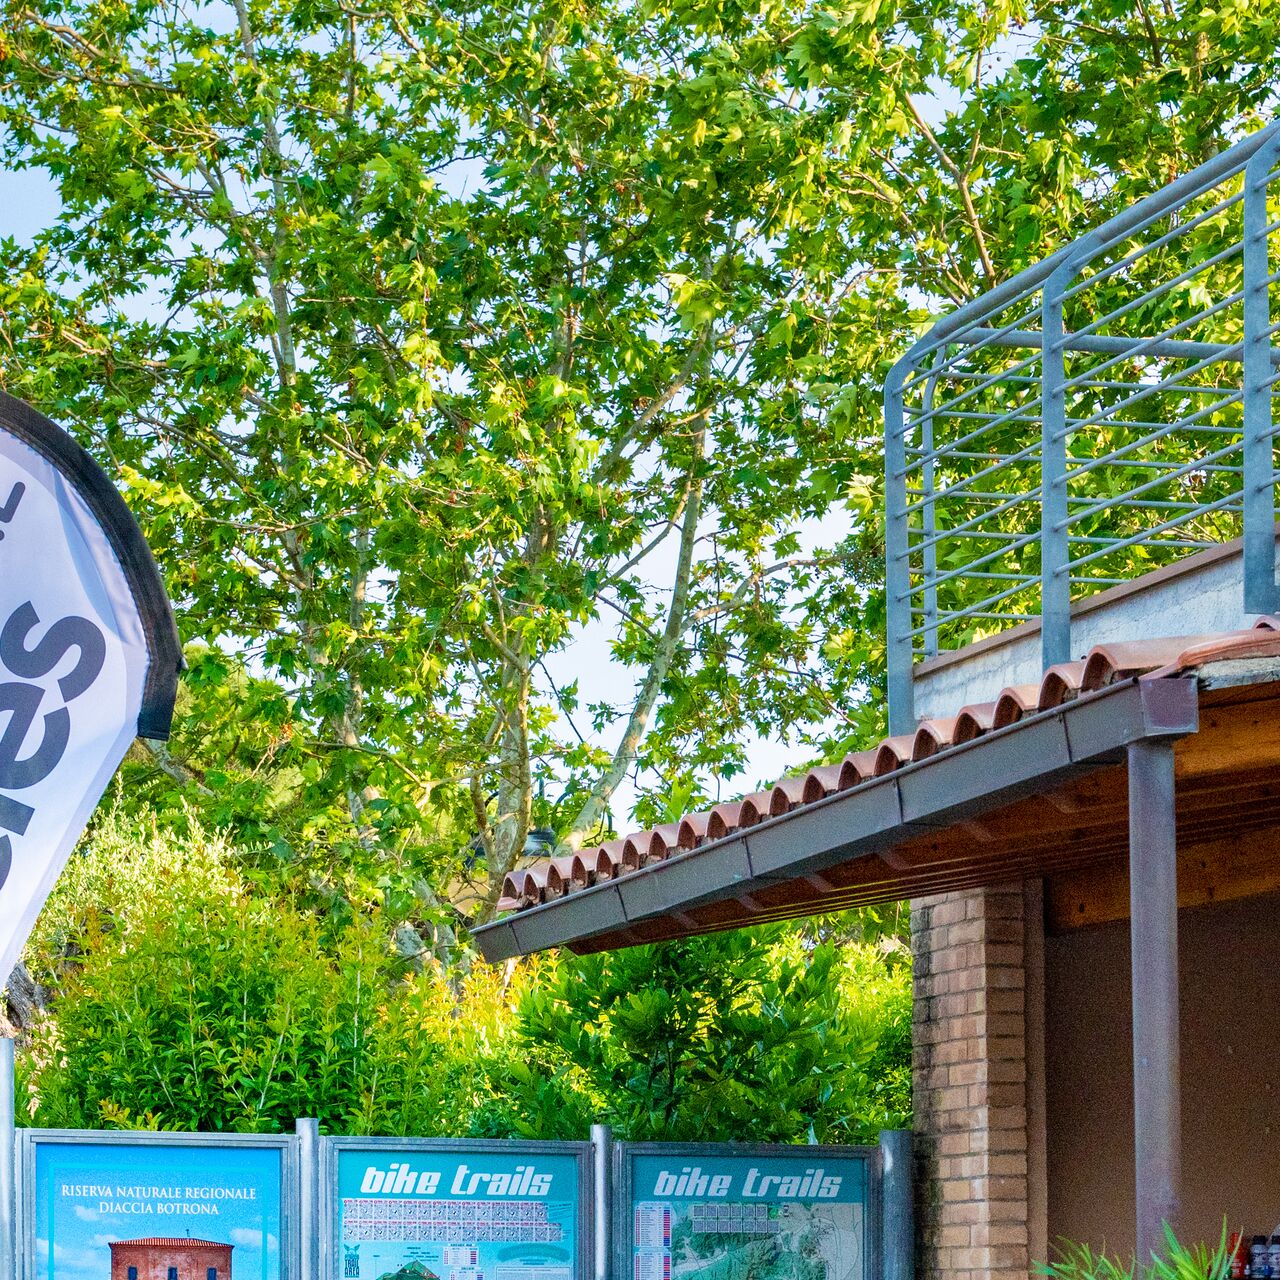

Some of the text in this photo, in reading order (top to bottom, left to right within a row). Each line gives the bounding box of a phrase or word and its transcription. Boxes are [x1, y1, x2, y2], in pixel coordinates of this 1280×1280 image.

[360, 1162, 554, 1197] bike trails
[653, 1166, 843, 1198] bike trails
[61, 1184, 256, 1200] RISERVA NATURALE REGIONALE
[99, 1202, 219, 1215] DIACCIA BOTRONA
